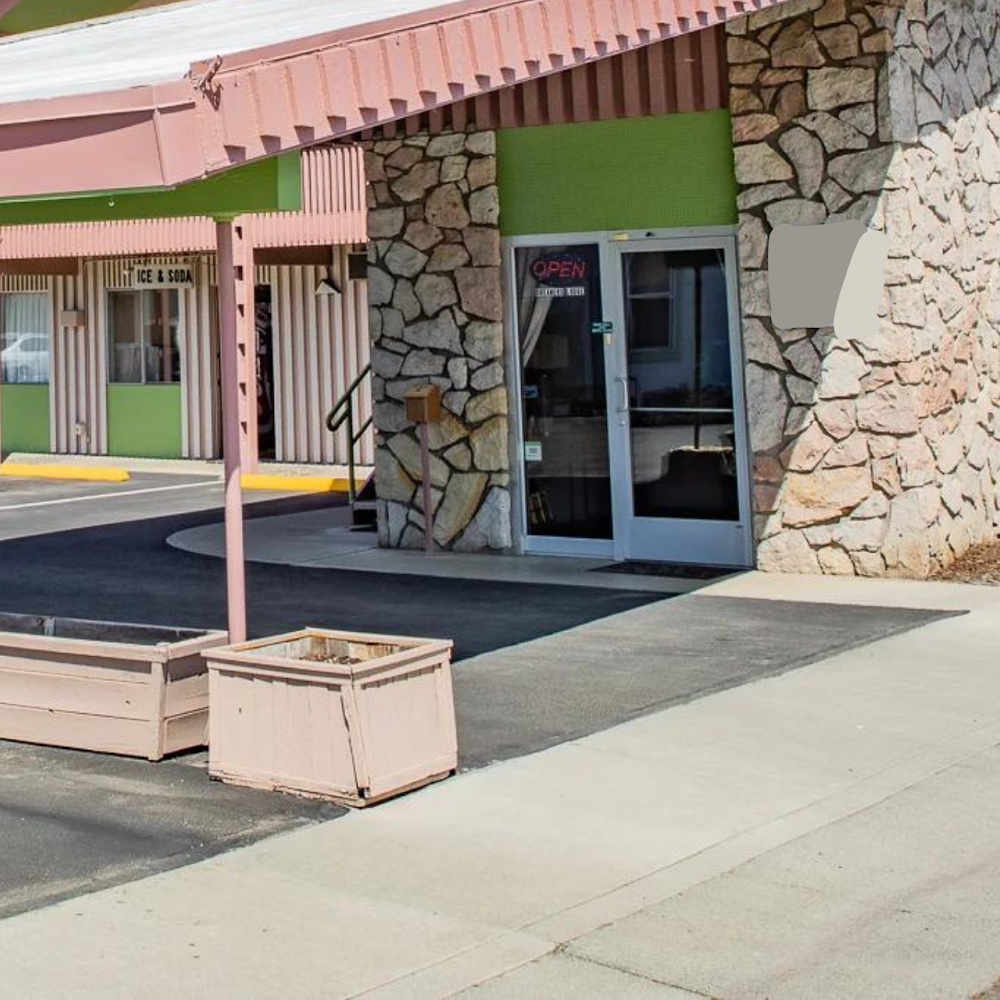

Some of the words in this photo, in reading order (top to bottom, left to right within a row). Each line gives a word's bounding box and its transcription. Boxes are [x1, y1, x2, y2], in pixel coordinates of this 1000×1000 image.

[137, 268, 152, 284] ICE
[157, 268, 164, 283] &
[168, 268, 193, 284] SODA
[533, 260, 586, 280] OPEN
